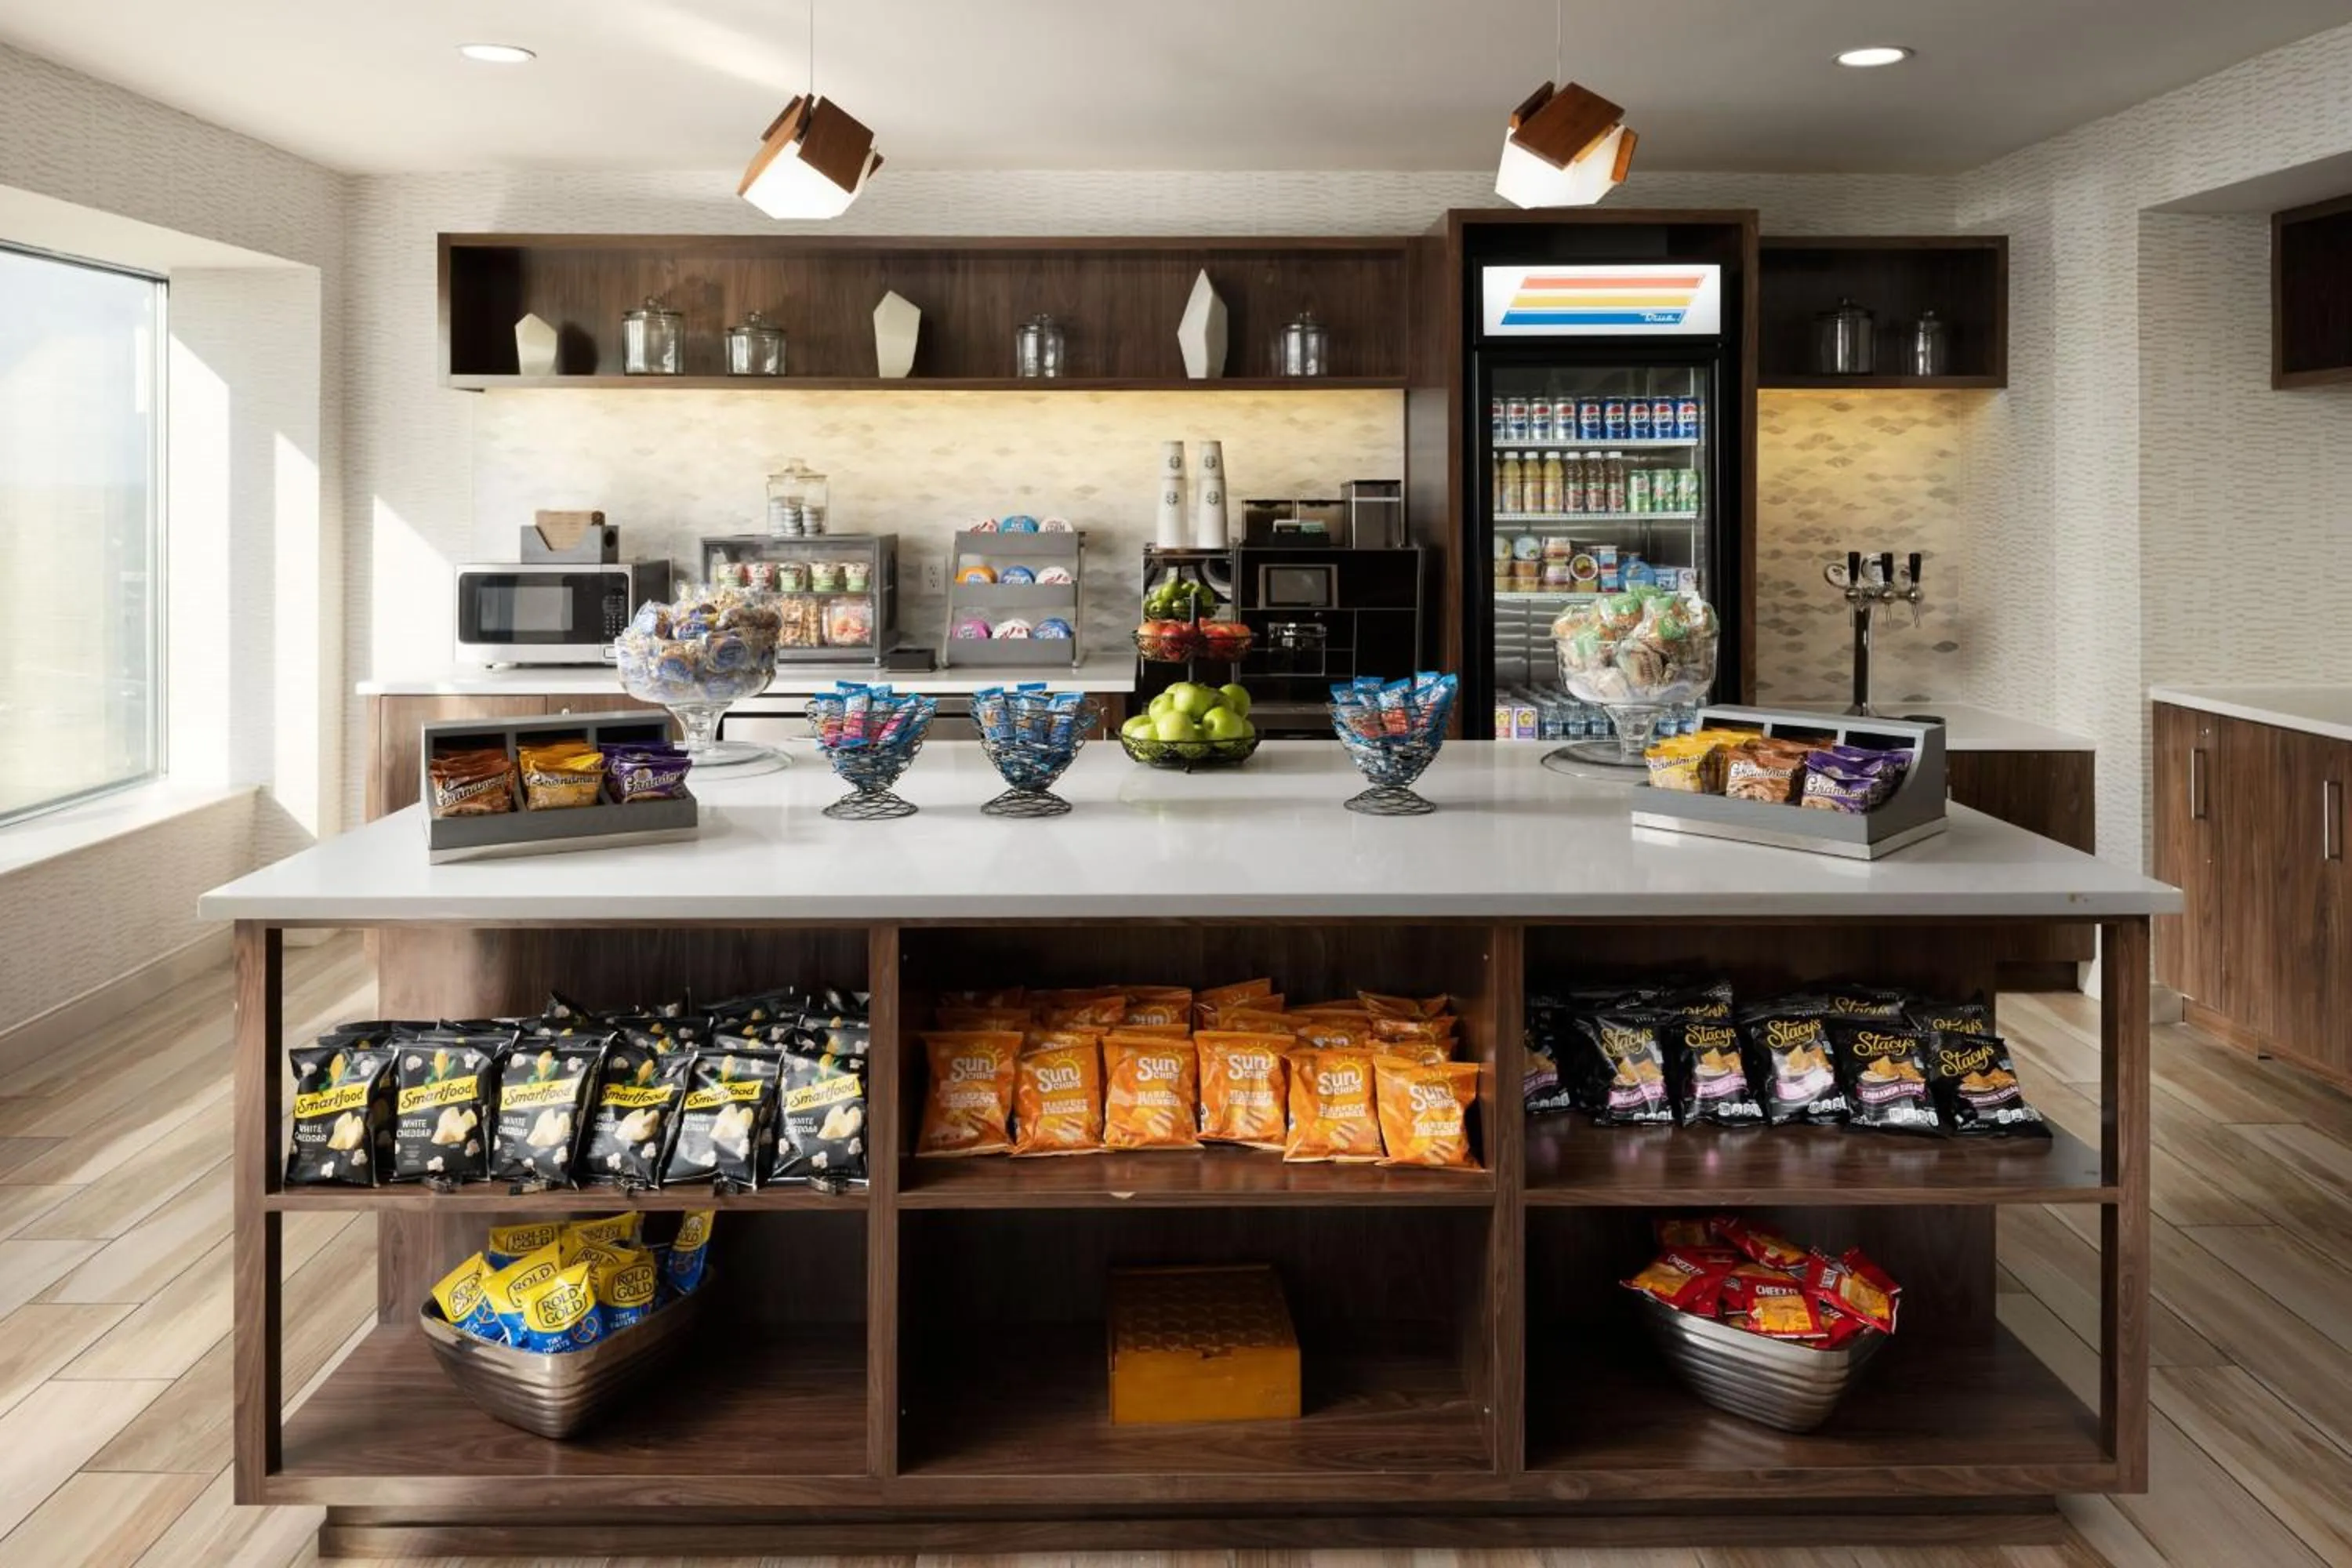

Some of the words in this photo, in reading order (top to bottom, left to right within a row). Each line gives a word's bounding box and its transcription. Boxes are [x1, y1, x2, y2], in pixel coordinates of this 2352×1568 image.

[951, 1057, 996, 1083] Sun
[1137, 1056, 1179, 1081] Sun
[1228, 1054, 1272, 1080] Sun
[1036, 1067, 1080, 1093] Sun
[1317, 1070, 1362, 1095] Sun
[298, 1086, 365, 1114] Smartfood
[401, 1083, 472, 1109] Smartfood
[1409, 1083, 1453, 1112] Sun
[402, 1119, 427, 1128] WHITE
[512, 1266, 552, 1291] ROLD
[616, 1268, 651, 1286] ROLD
[616, 1281, 652, 1298] GOLD
[542, 1287, 579, 1312] ROLD
[544, 1298, 583, 1324] GOLD
